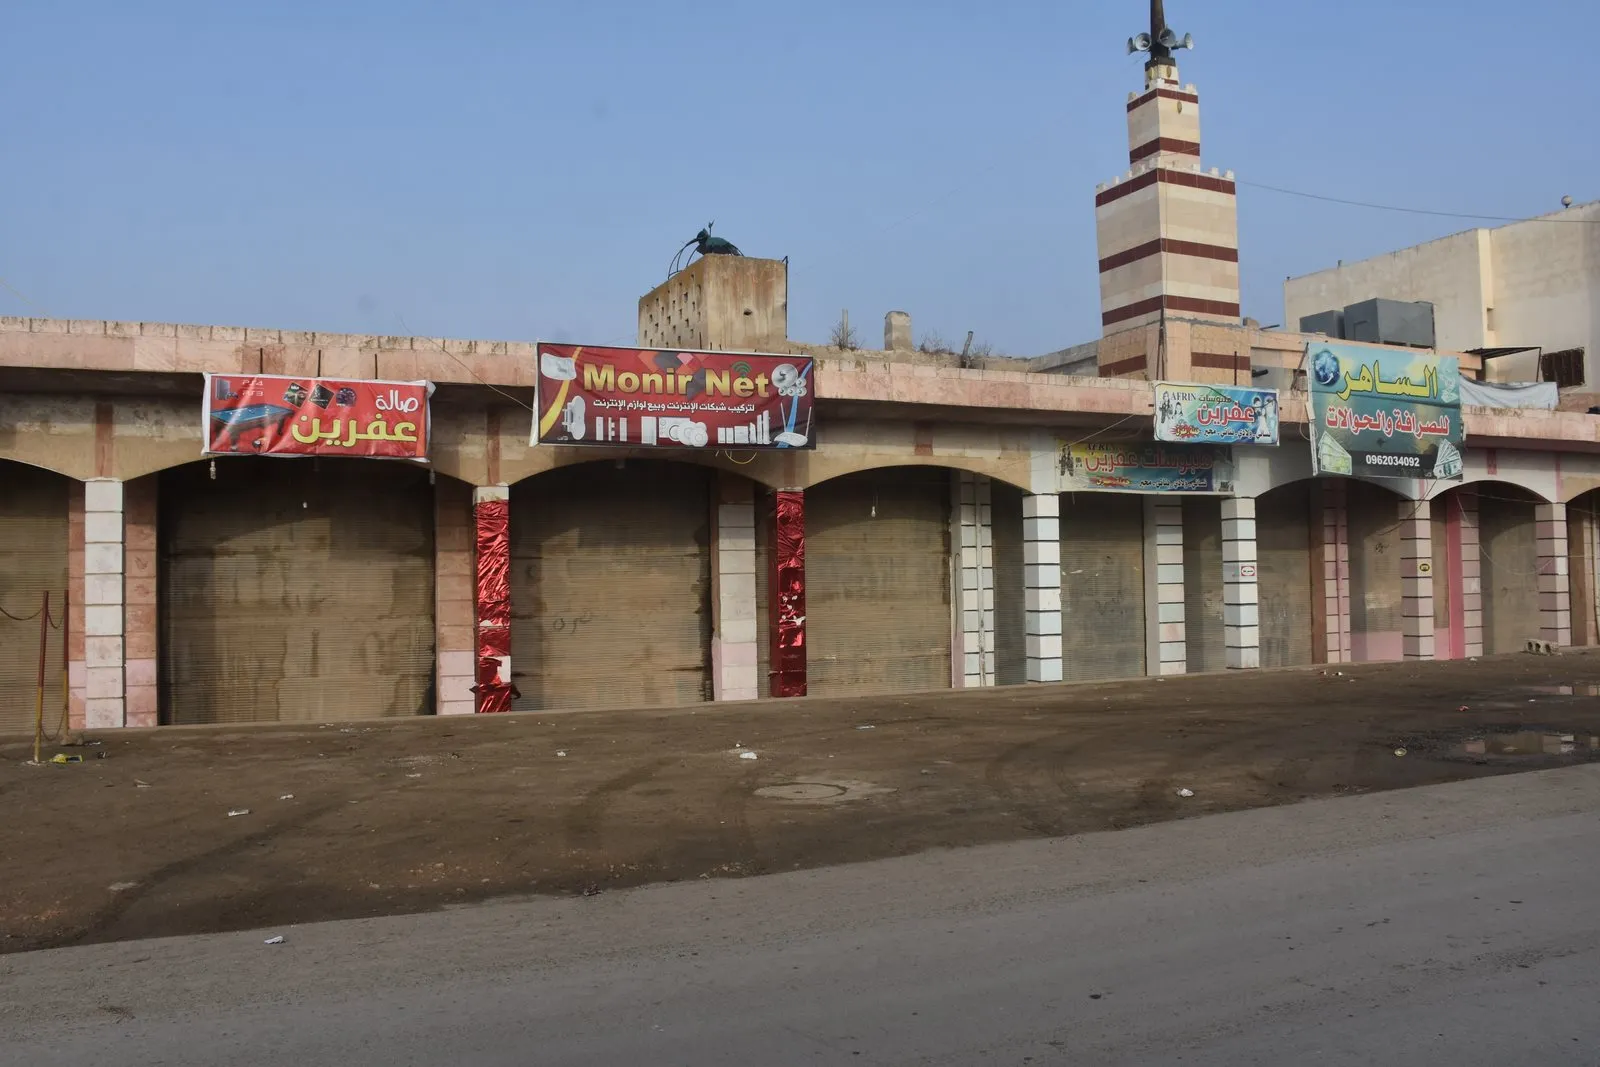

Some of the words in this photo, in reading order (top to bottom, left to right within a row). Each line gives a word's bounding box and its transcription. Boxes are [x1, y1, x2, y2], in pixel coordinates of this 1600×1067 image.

[583, 363, 694, 394] Monir
[705, 371, 771, 398] Net
[1336, 360, 1438, 401] الساهر
[375, 389, 419, 413] صالة
[626, 400, 647, 411] لوازم
[647, 401, 667, 412] وبيع
[699, 402, 727, 412] شبكات
[727, 404, 755, 413] لتركيب
[1171, 391, 1197, 402] AFRIN
[1196, 401, 1256, 426] عفرين
[1325, 405, 1393, 437] والحوالات
[1392, 408, 1450, 440] للصرافة
[291, 413, 418, 448] عفرين
[1085, 449, 1139, 473] عفرين
[1141, 447, 1214, 475] ملبوسات
[1365, 454, 1420, 467] 0962034092
